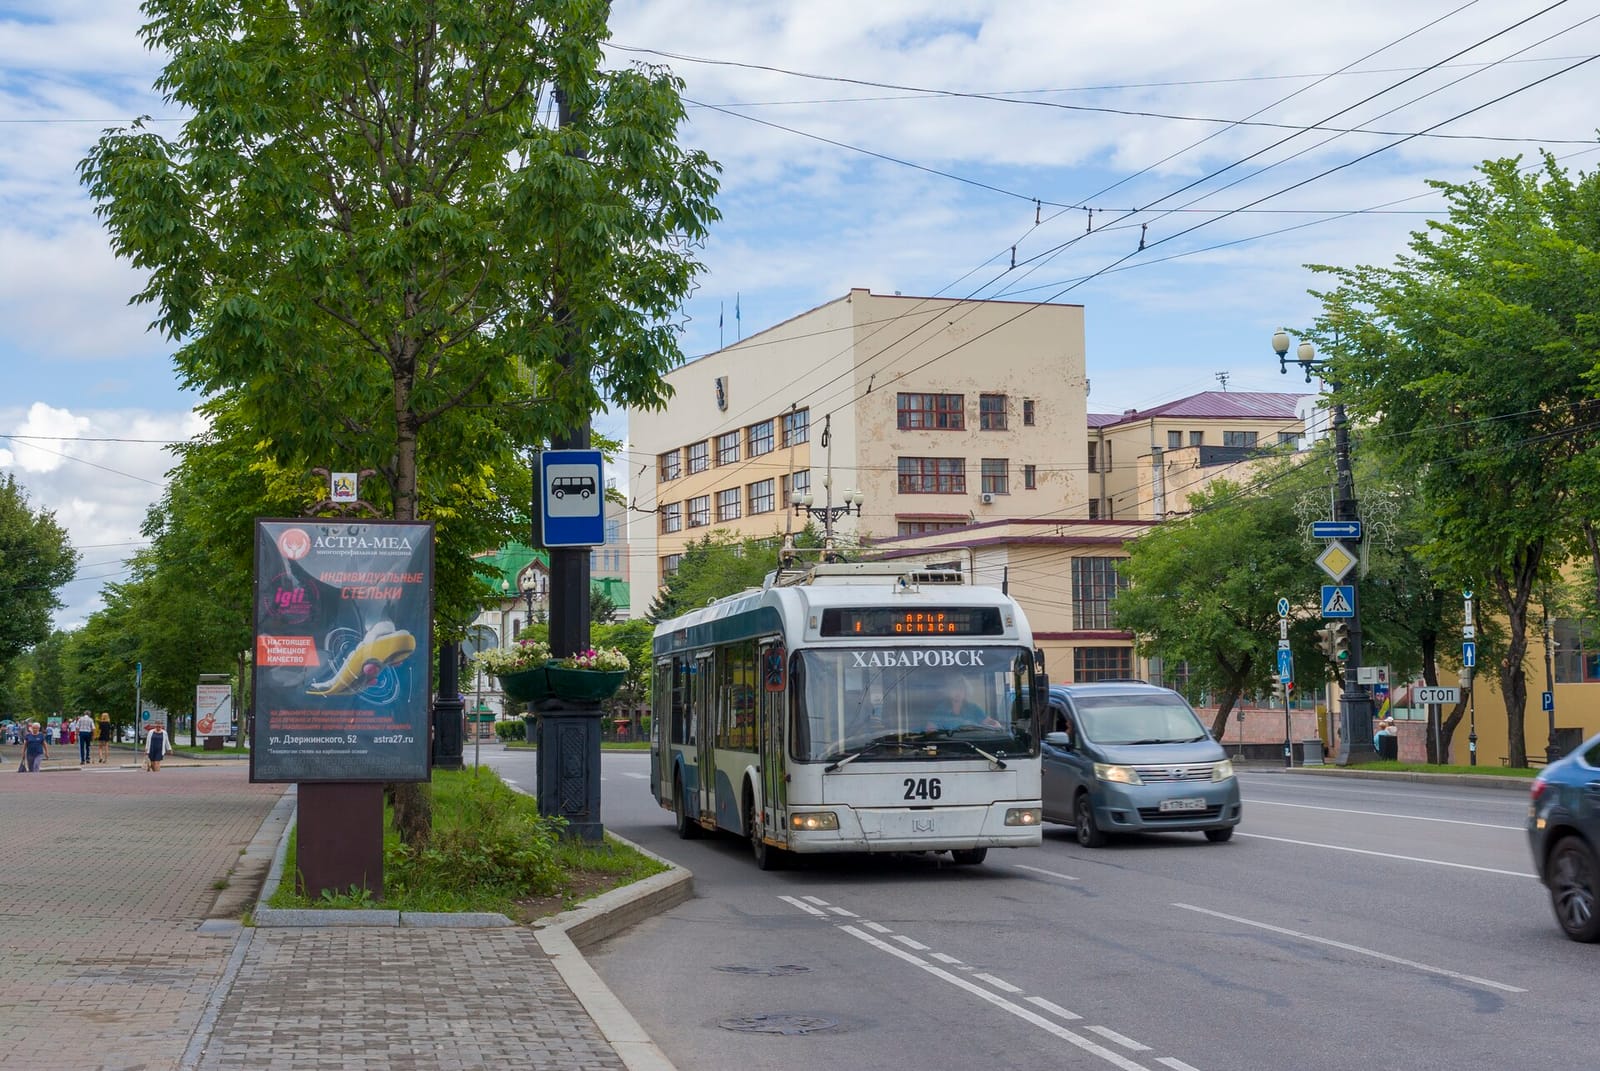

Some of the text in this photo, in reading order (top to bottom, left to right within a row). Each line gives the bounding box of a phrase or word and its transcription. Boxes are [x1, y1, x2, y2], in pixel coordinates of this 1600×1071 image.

[312, 536, 413, 550] АСТРА-МЕД
[320, 571, 424, 583] ИНДИВИДУАЛЬНЫЕ
[275, 587, 305, 608] igli
[341, 586, 403, 600] СТЕЛЬКИ
[267, 639, 311, 647] НАСТОЯЩЕЕ
[267, 655, 304, 663] КАЧЕСТВО
[852, 650, 985, 668] ХАБАРОВСК
[1419, 689, 1455, 701] СТОП
[269, 735, 357, 746] ул. Дзержинского, 52
[373, 734, 414, 744] astra27.ru
[903, 778, 942, 800] 246
